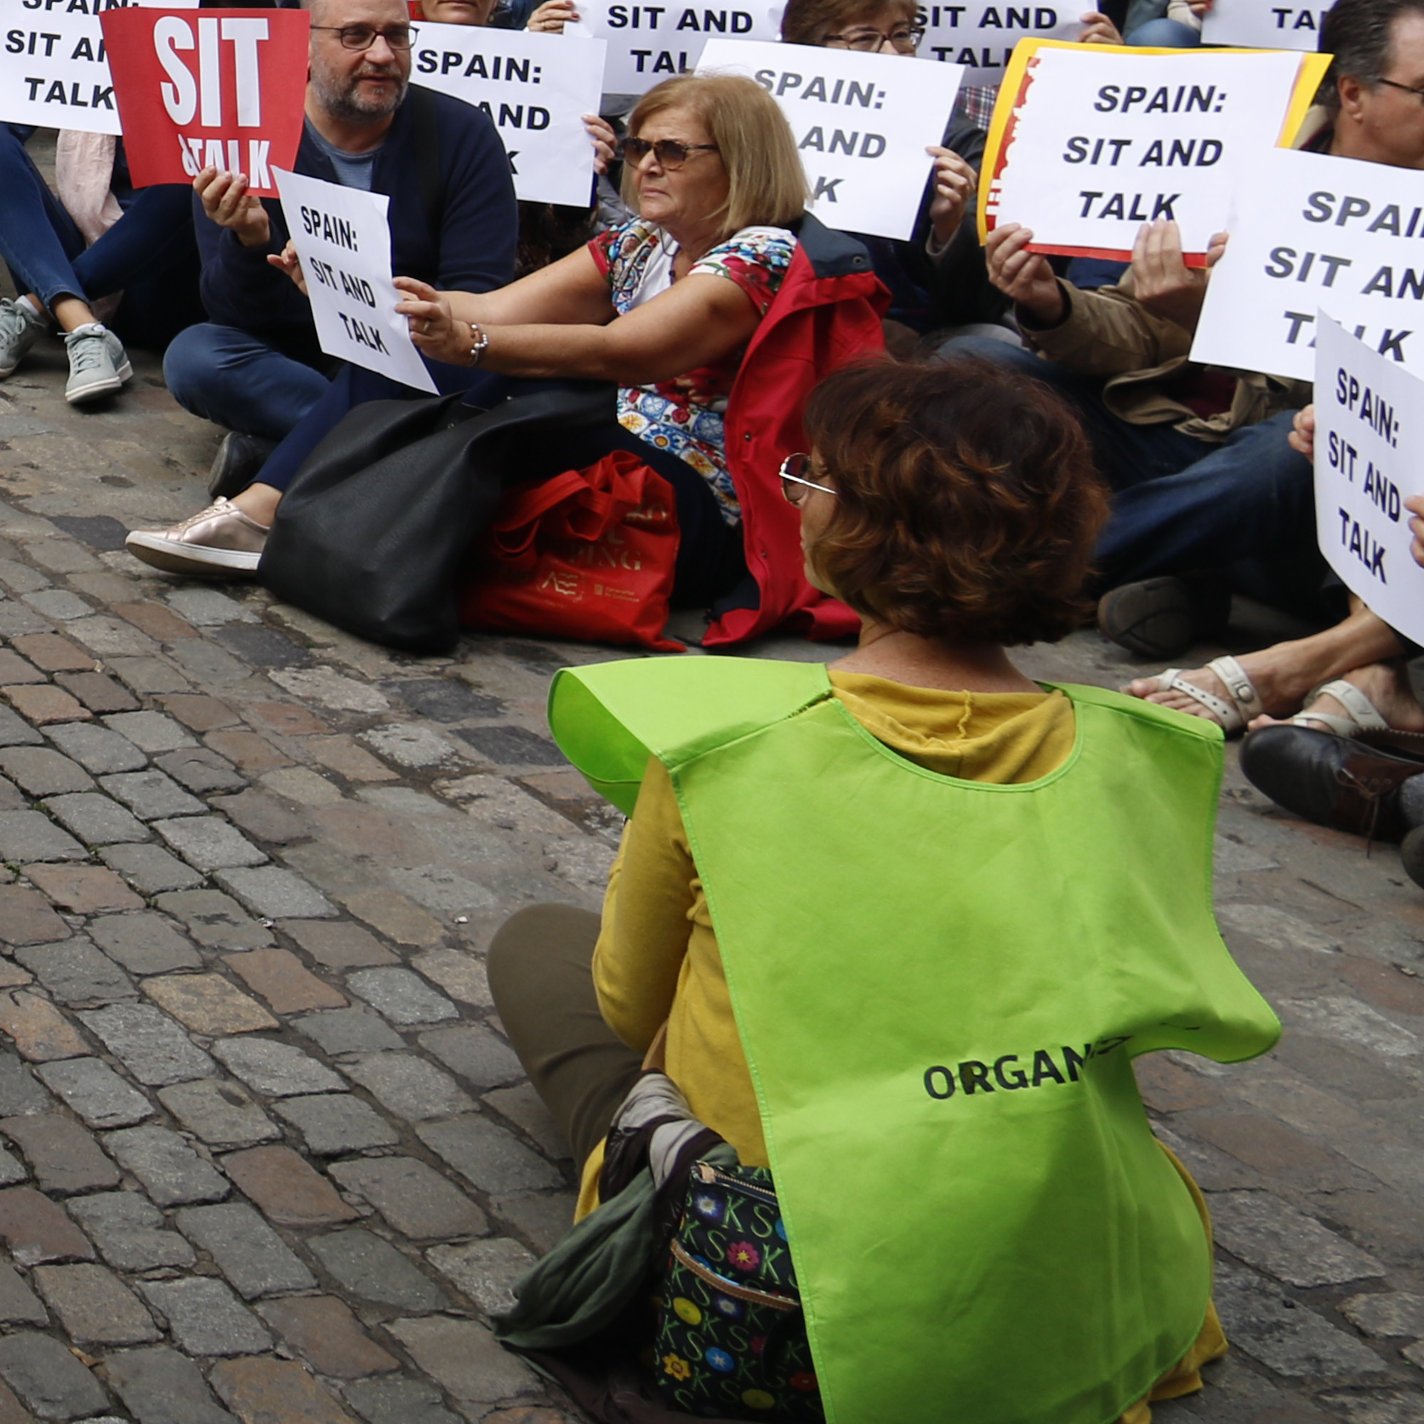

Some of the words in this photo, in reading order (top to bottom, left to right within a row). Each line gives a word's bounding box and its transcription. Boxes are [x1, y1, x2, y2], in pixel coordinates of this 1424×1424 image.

[608, 6, 665, 29] SIT
[676, 9, 752, 33] AND
[978, 7, 1058, 30] AND
[6, 30, 61, 56] SIT
[154, 16, 269, 127] SIT
[417, 50, 541, 83] SPAIN:
[25, 77, 115, 110] TALK
[1094, 85, 1226, 113] SPAIN:
[799, 127, 887, 158] AND
[1063, 137, 1132, 166] SIT
[1139, 139, 1222, 166] AND
[1080, 191, 1180, 221] TALK
[301, 206, 357, 251] SPAIN:
[310, 257, 337, 290] SIT
[341, 275, 376, 309] AND
[1265, 247, 1352, 287] SIT
[338, 312, 389, 355] TALK
[1336, 367, 1400, 448] SPAIN:
[1329, 431, 1357, 481] SIT
[1364, 462, 1401, 523] AND
[1338, 508, 1388, 586] TALK
